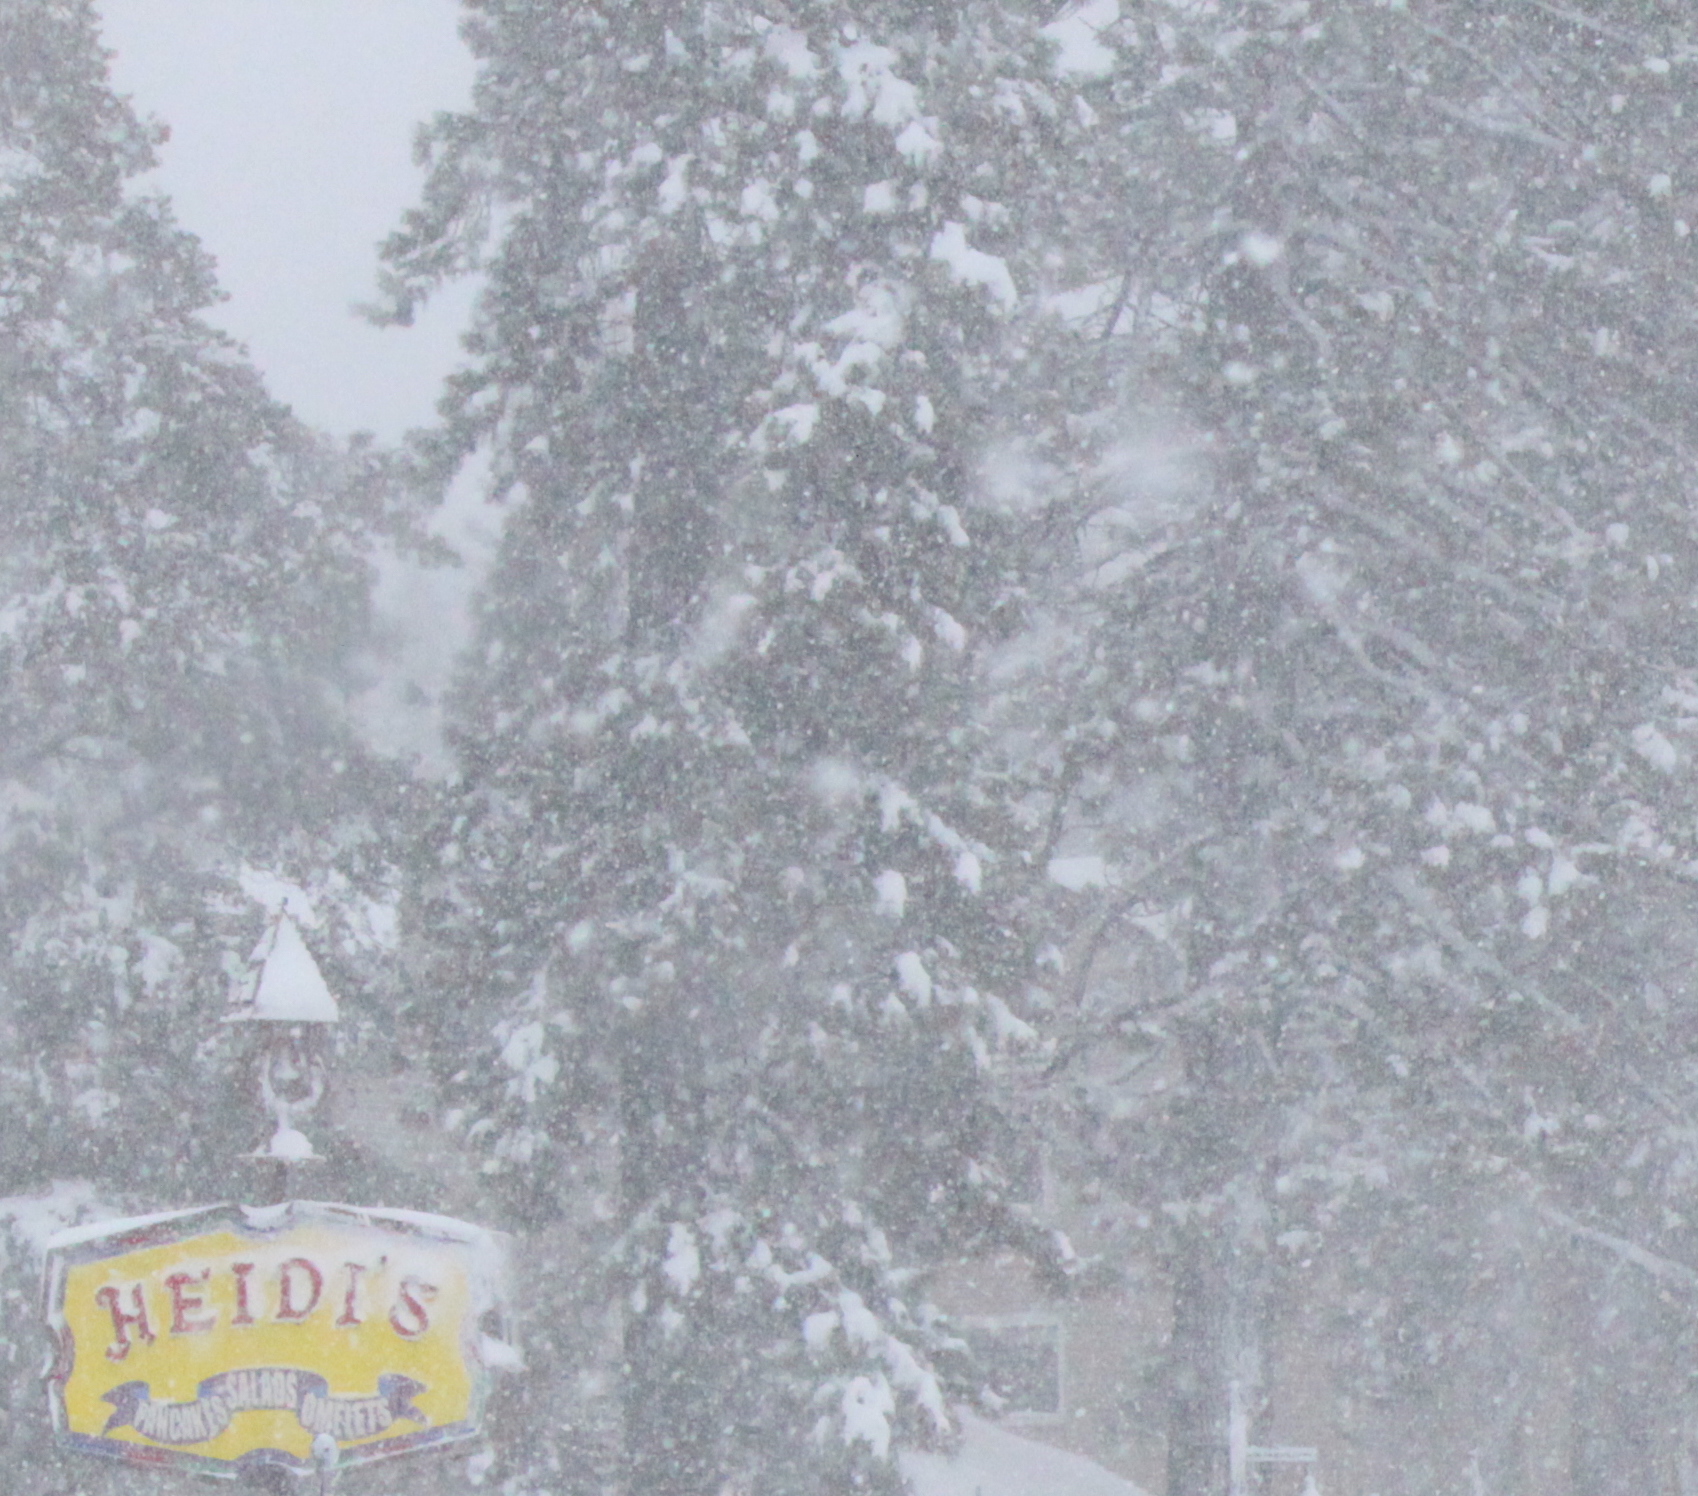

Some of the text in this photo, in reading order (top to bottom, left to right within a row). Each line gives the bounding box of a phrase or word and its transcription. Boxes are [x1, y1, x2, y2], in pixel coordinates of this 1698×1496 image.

[94, 1254, 439, 1362] HEIDI'S
[224, 1369, 298, 1411] SALADS
[133, 1394, 229, 1442] PANCAKES
